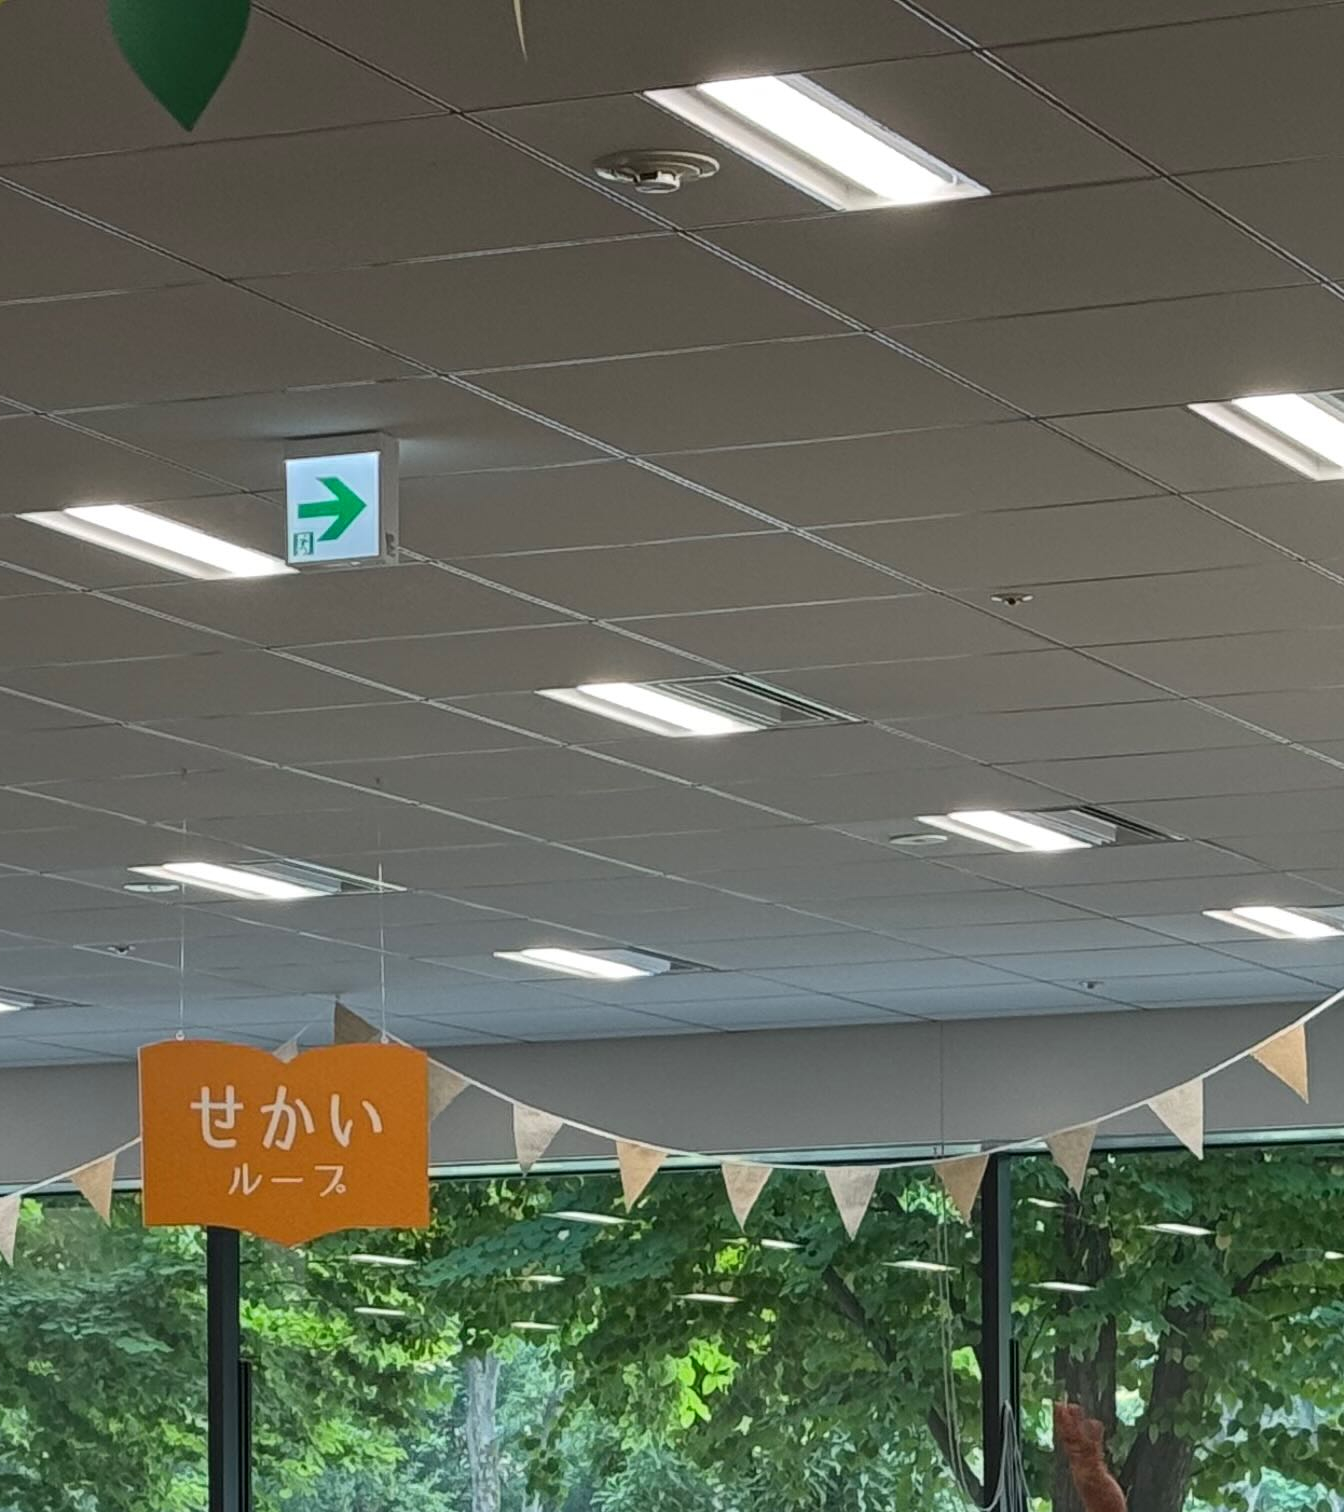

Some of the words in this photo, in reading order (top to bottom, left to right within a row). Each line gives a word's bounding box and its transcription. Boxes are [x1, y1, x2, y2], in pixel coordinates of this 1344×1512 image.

[190, 1085, 383, 1150] せかい
[228, 1163, 346, 1196] ループ
